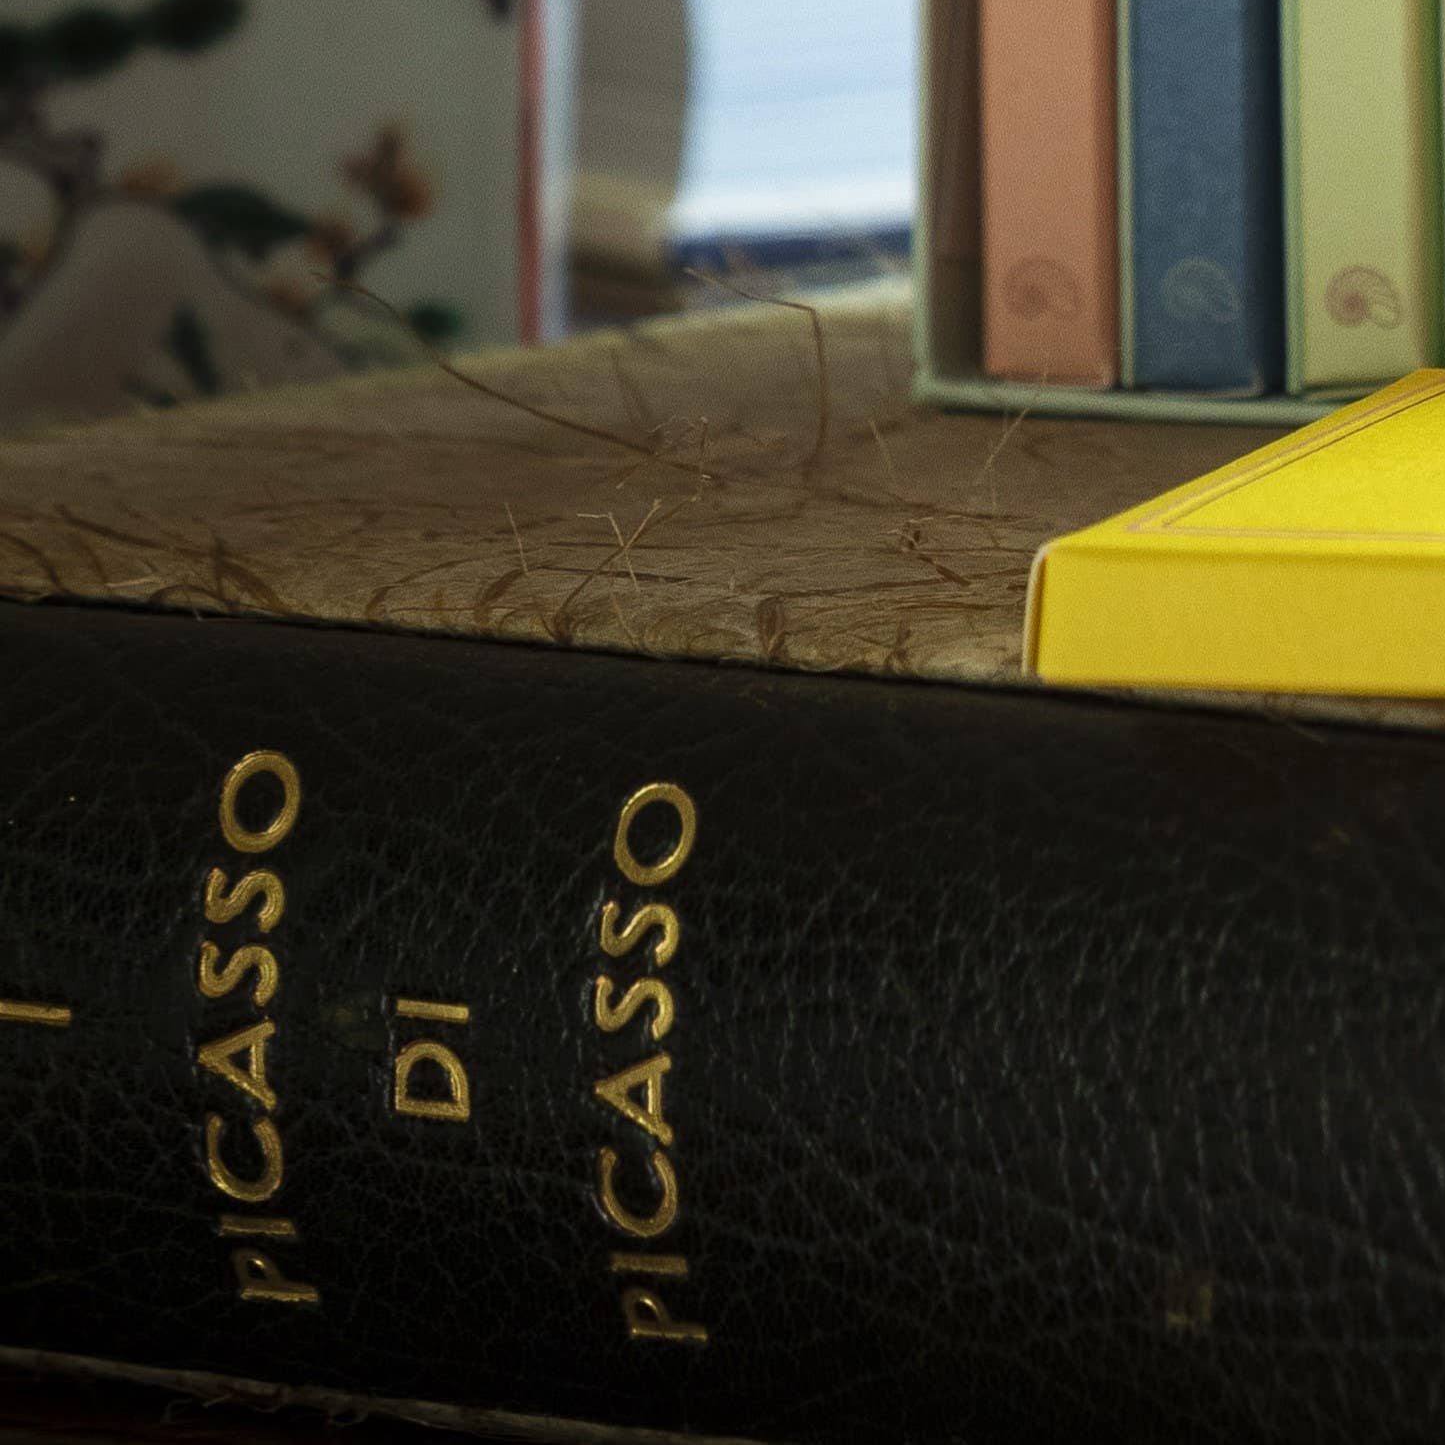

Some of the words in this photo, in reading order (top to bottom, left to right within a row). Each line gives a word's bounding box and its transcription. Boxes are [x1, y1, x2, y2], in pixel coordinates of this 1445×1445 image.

[199, 749, 319, 1303] PICASSO
[396, 999, 471, 1122] DI
[595, 781, 708, 1342] PICASSO
